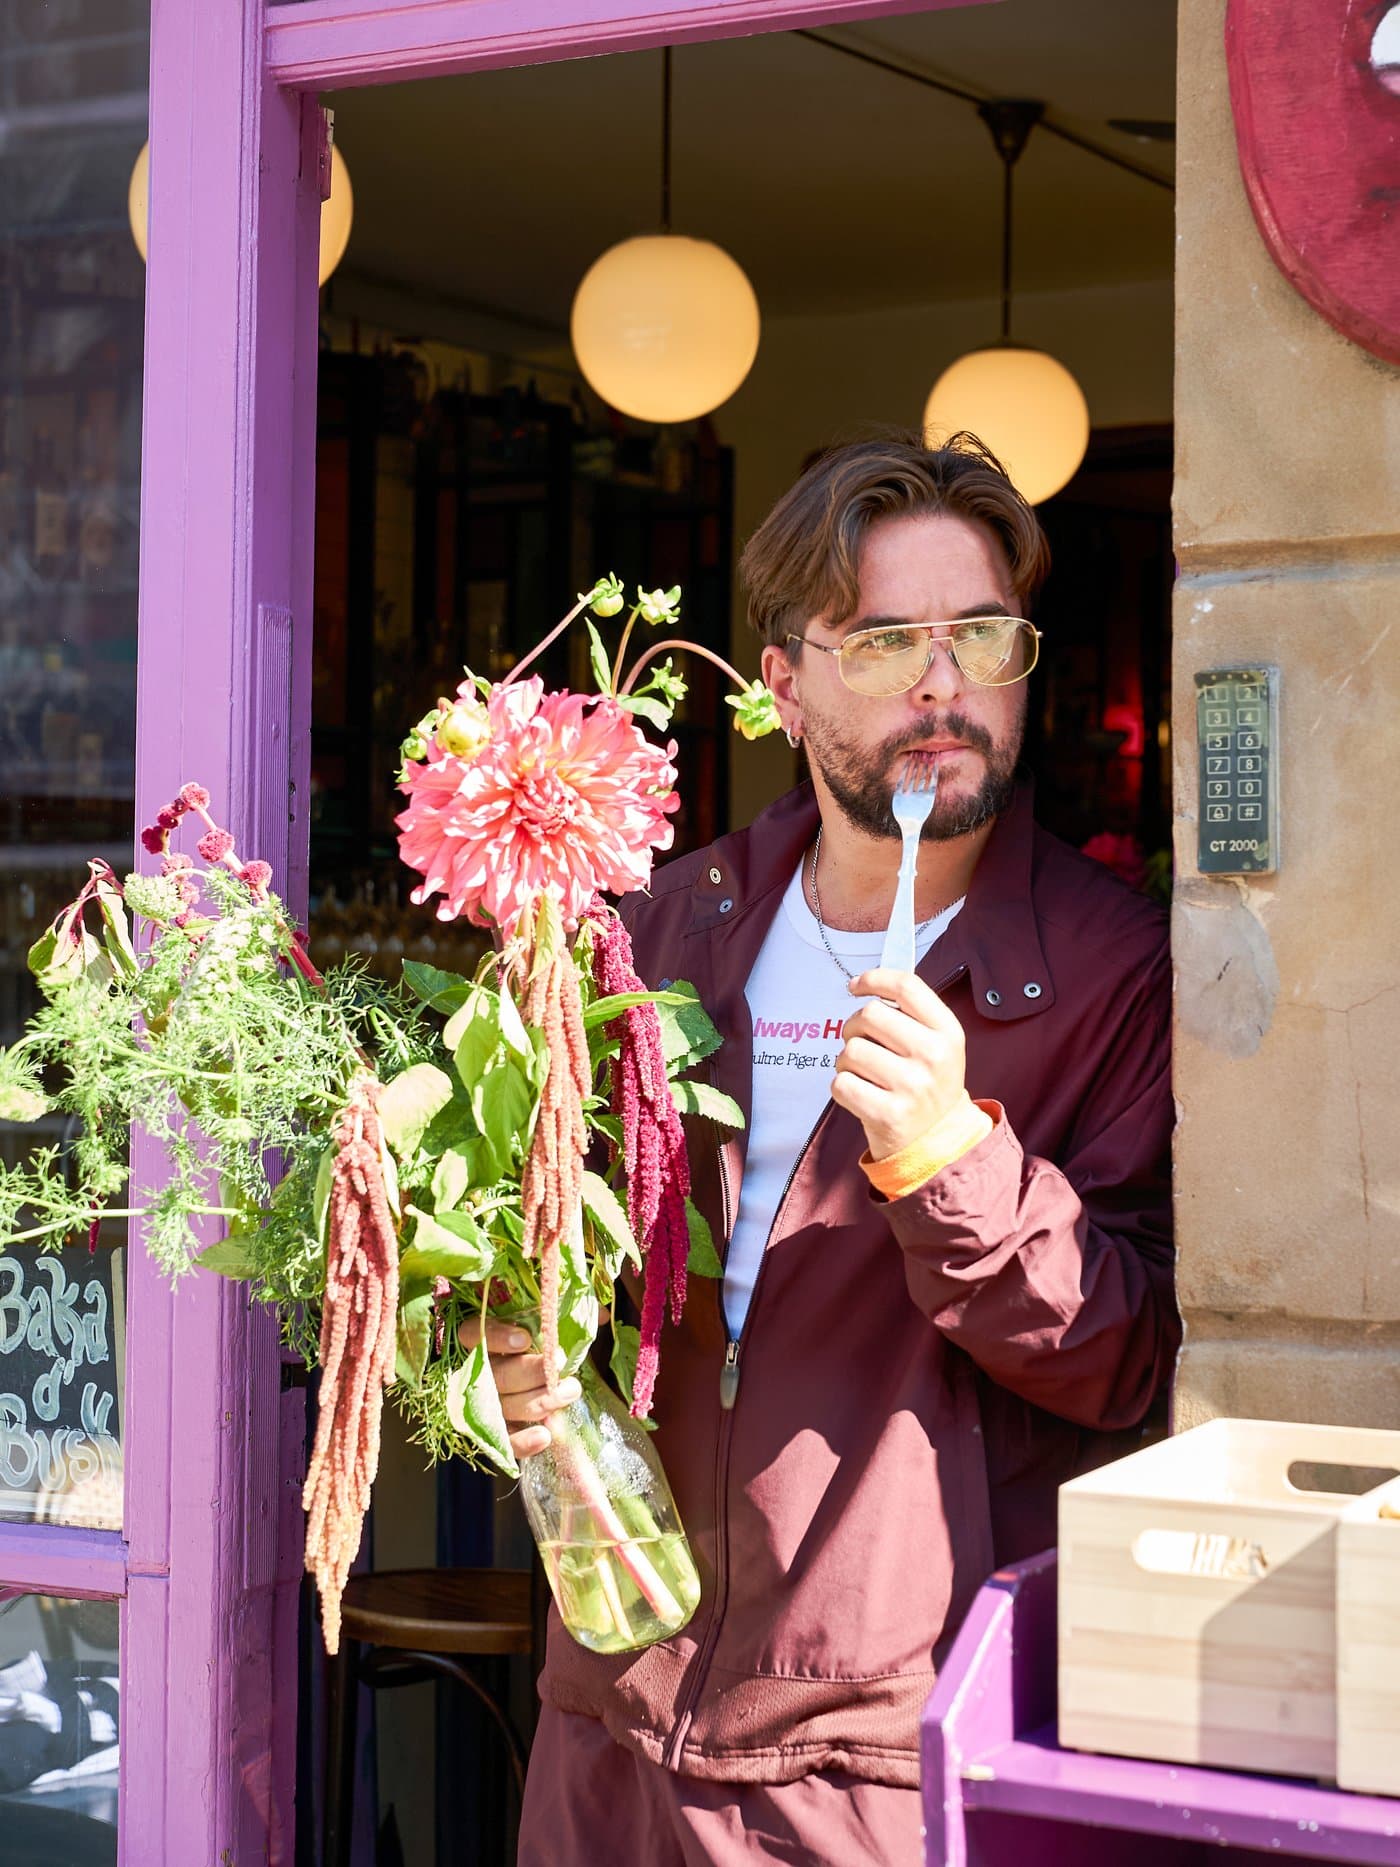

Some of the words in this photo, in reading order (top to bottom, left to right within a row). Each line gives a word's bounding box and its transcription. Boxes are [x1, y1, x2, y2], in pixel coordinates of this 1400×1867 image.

[1244, 687, 1252, 698] 2
[1214, 712, 1222, 724] 3
[1244, 711, 1252, 723] 4
[1215, 736, 1222, 748] 5
[1245, 735, 1253, 747] 6
[1215, 760, 1222, 771] 7
[1245, 758, 1253, 770] 8
[1215, 783, 1222, 795] 9
[1245, 782, 1254, 794] 0
[1210, 840, 1226, 852] CT
[1230, 839, 1258, 852] 2000
[753, 1051, 784, 1066] ultne
[787, 1053, 818, 1069] Piger
[820, 1054, 831, 1067] &
[0, 1257, 109, 1364] Baka
